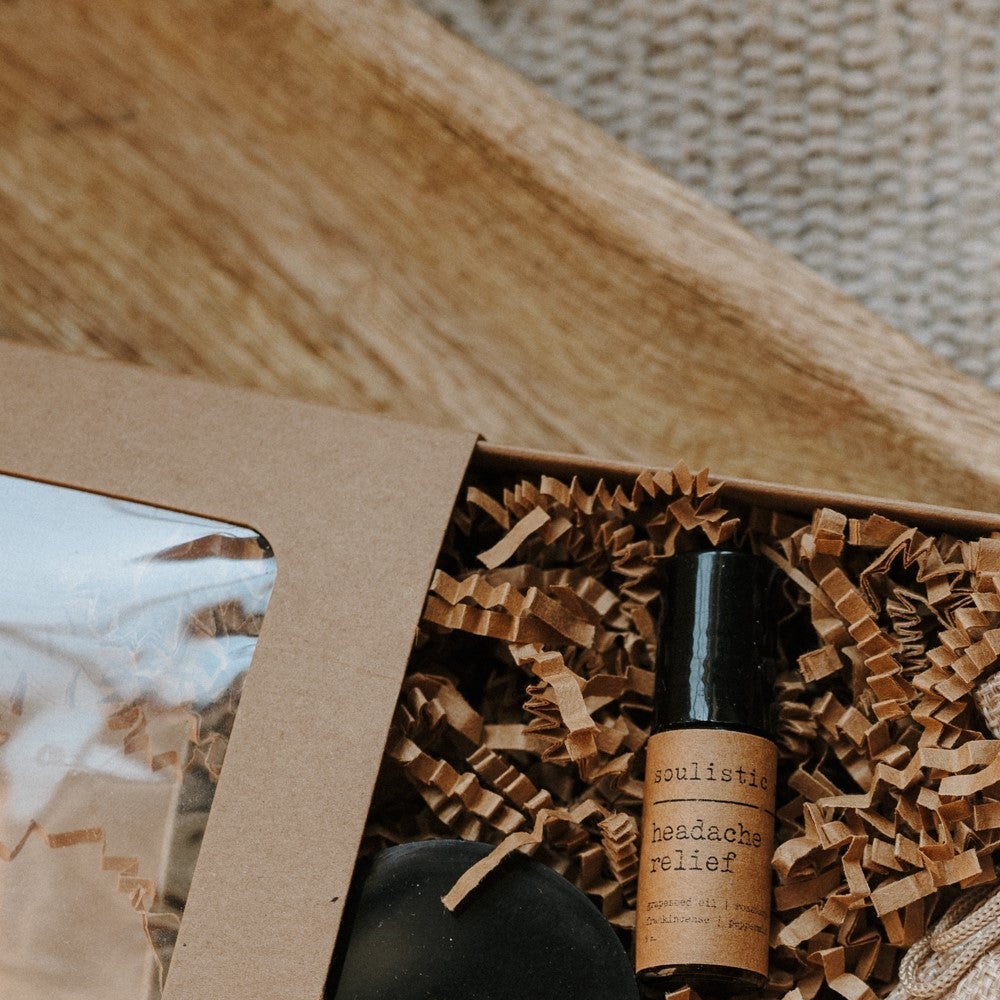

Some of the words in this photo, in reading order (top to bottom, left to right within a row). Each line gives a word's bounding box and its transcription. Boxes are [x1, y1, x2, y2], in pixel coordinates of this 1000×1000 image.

[653, 762, 769, 791] soulistic
[650, 819, 762, 848] headache
[649, 849, 737, 874] relief
